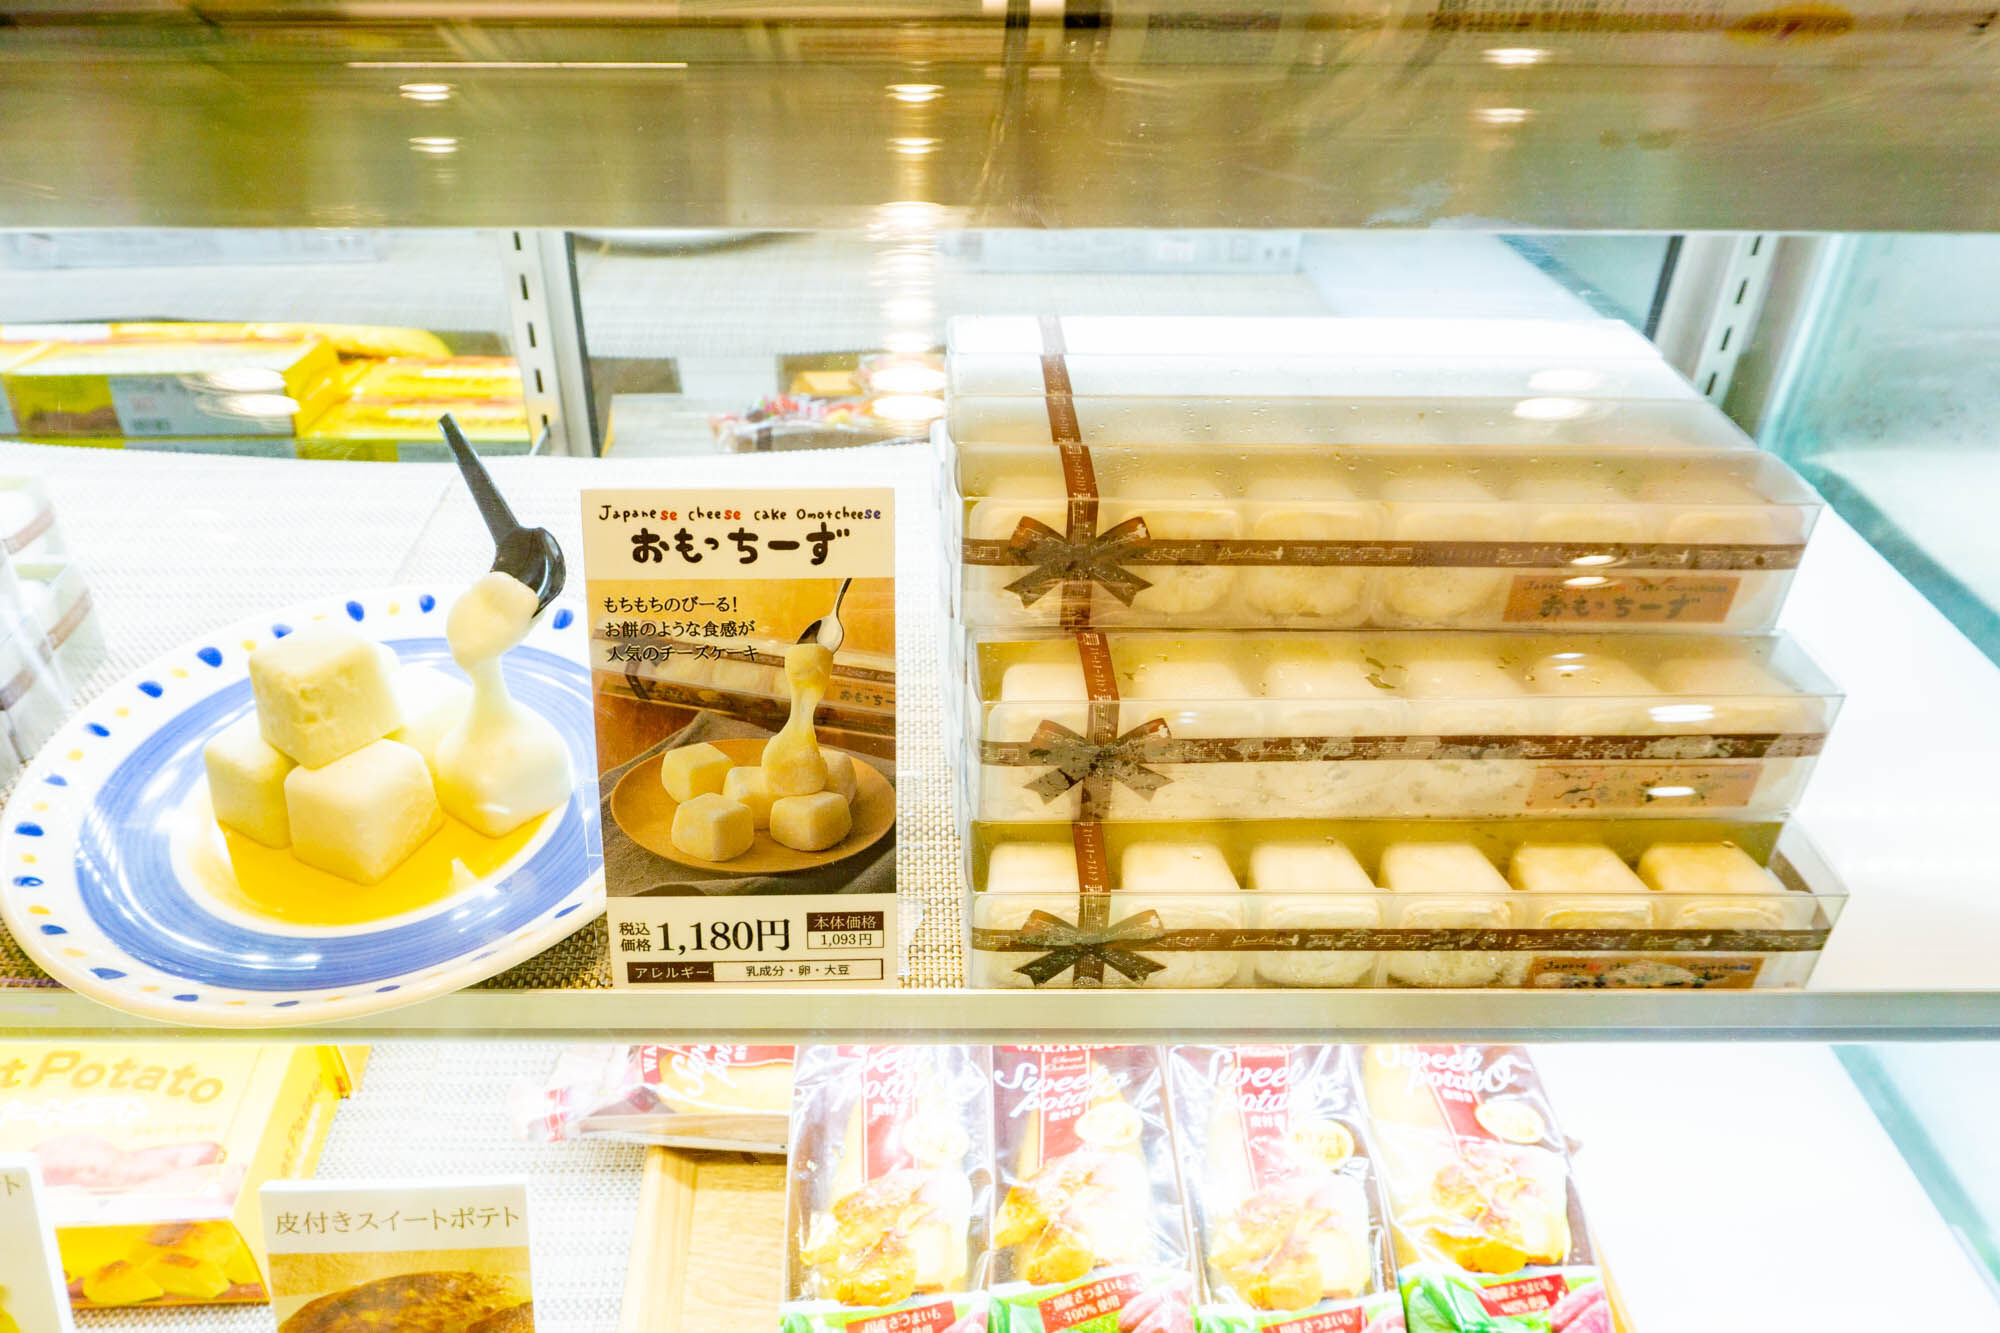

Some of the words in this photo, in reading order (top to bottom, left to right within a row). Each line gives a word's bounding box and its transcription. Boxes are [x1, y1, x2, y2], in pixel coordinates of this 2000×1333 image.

[598, 504, 677, 522] Japanese
[688, 506, 741, 521] cheese
[753, 507, 787, 521] cake
[796, 506, 881, 521] Omotcheese
[630, 522, 850, 565] おもっちーず
[603, 596, 738, 614] もちもちのびーる!
[605, 620, 755, 638] お餅のような食感が
[607, 645, 759, 663] 人気のチーズケーキ
[619, 922, 650, 936] 税込
[814, 915, 877, 930] 本体価格
[620, 937, 651, 952] 価格
[657, 919, 790, 955] 1,180円
[821, 933, 872, 947] 1,093円
[635, 966, 709, 979] アレルギー
[745, 964, 850, 978] 乳成分・卵・大豆
[29, 1050, 224, 1105] Potato
[275, 1206, 521, 1236] 皮付きスイートポテト
